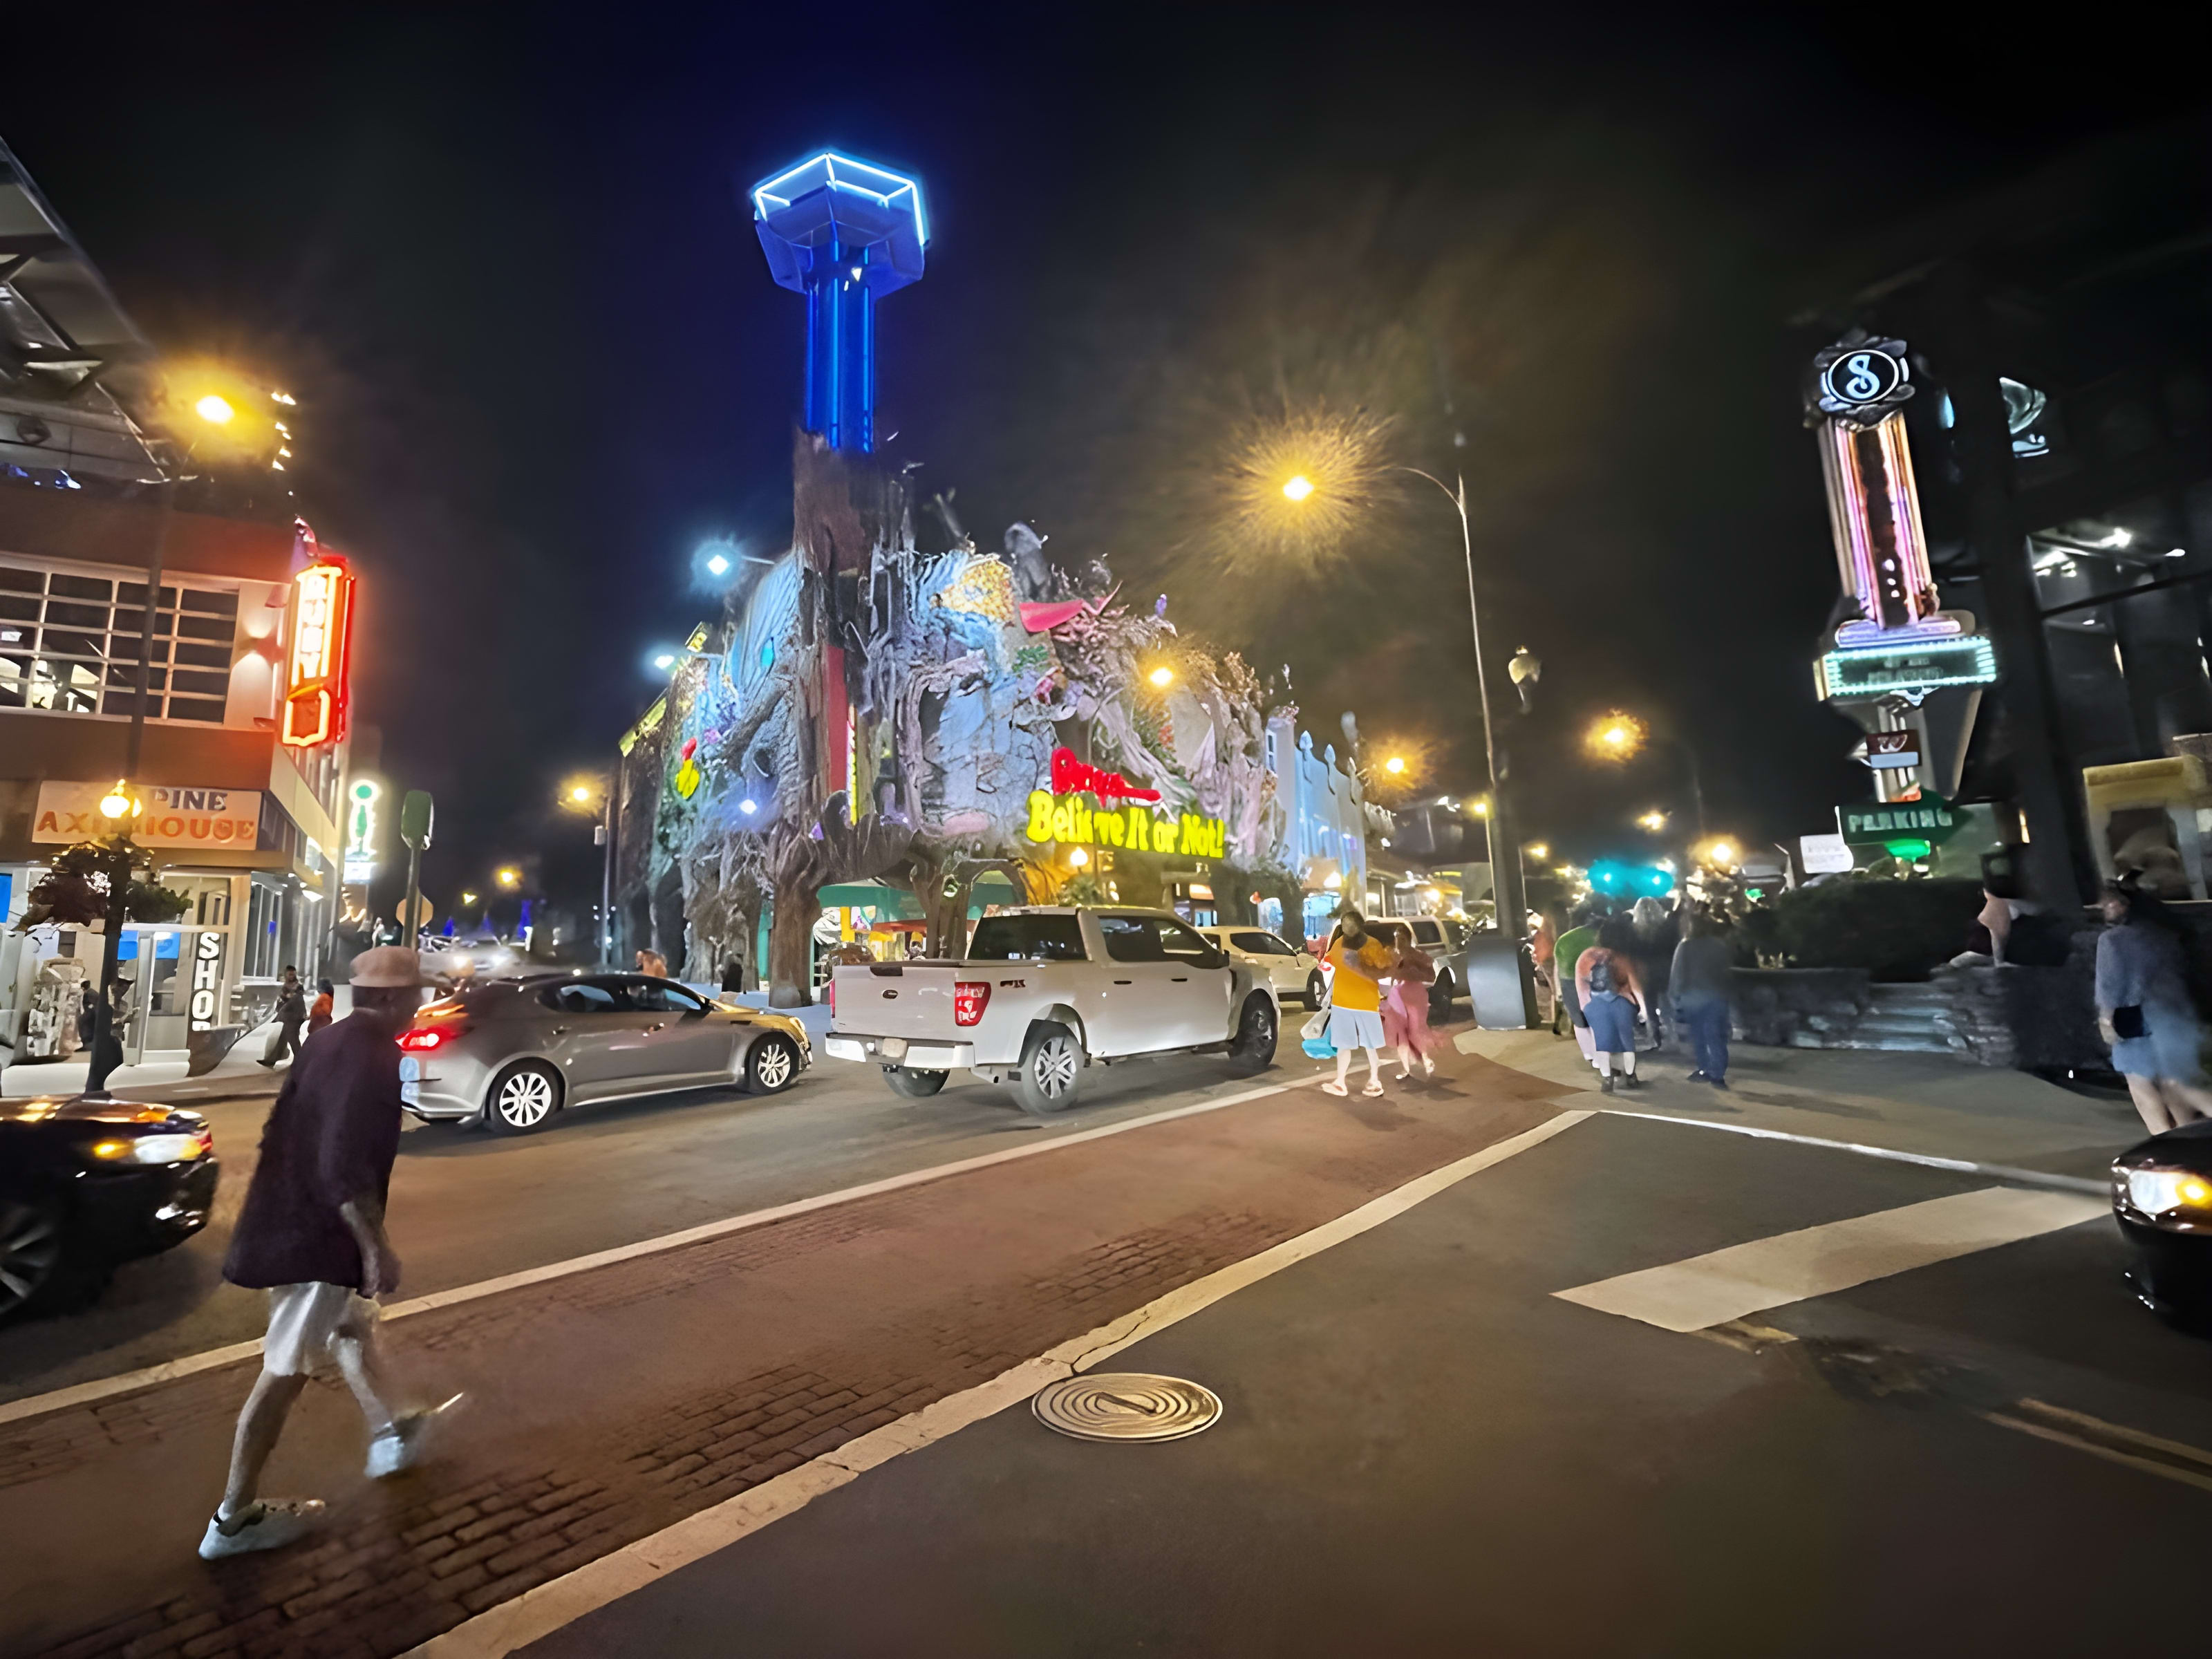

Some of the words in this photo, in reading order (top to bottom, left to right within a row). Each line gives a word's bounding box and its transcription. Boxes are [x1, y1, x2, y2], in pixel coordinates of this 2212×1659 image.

[1026, 789, 1125, 847] Believe
[1125, 807, 1149, 851] It
[1153, 821, 1179, 854] or
[1181, 812, 1225, 859] Not!
